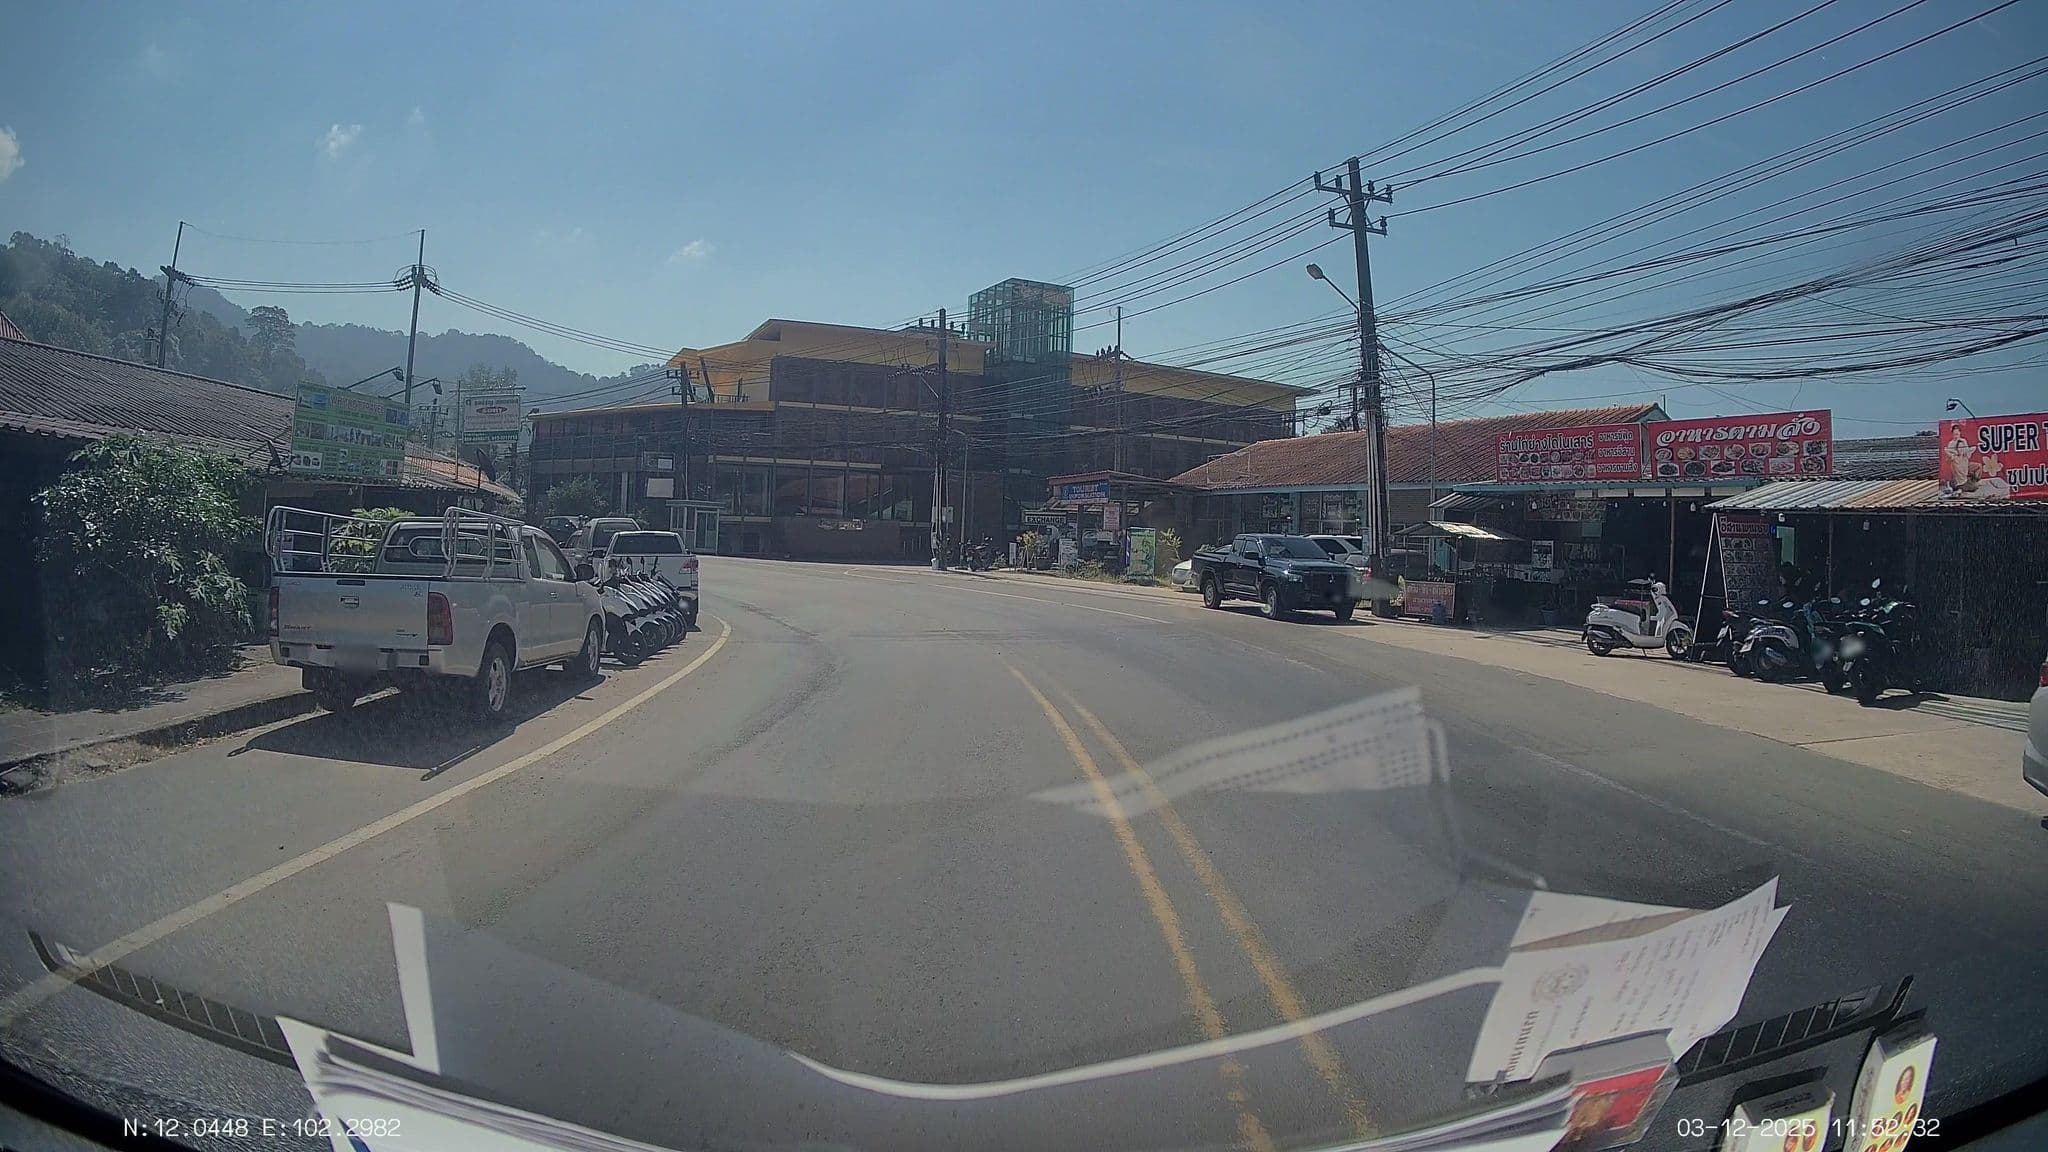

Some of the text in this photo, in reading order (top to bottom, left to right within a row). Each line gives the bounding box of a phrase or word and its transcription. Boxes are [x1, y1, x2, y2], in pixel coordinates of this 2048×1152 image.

[1499, 431, 1595, 453] ร้านไก่ย่างไดโนเสาร์
[1978, 423, 2039, 454] SUPER
[1027, 516, 1065, 524] EXCHANGE
